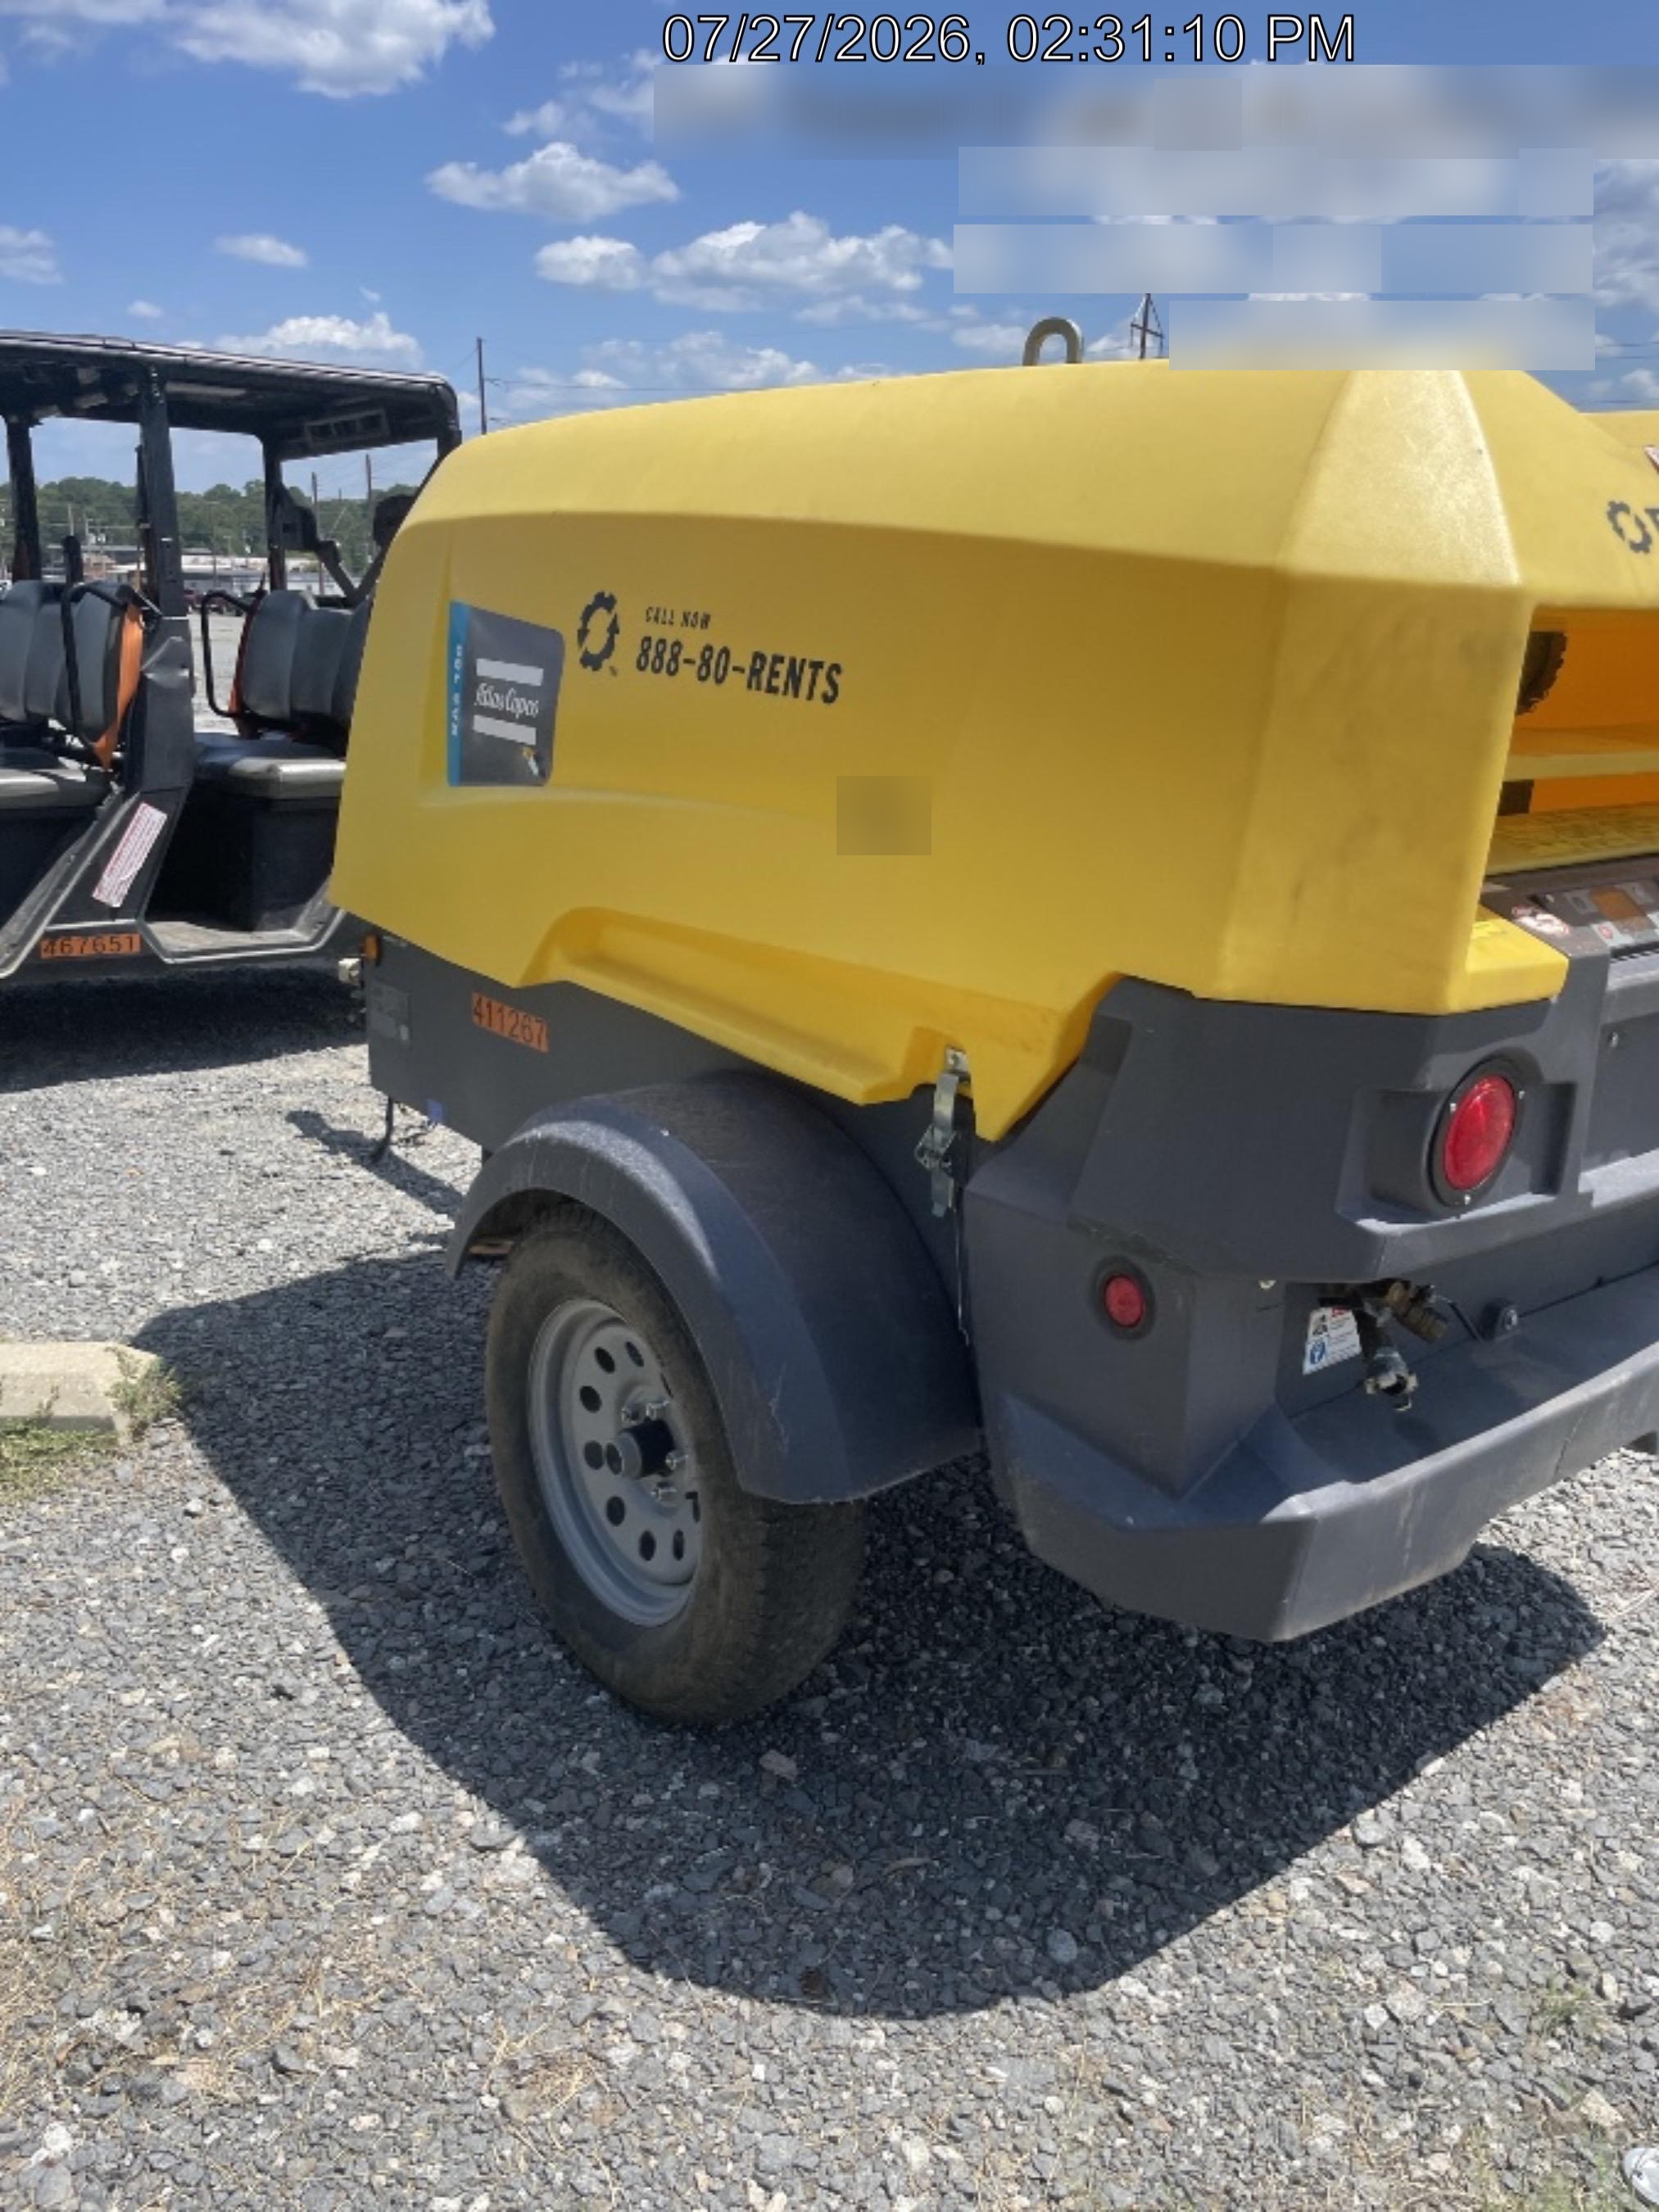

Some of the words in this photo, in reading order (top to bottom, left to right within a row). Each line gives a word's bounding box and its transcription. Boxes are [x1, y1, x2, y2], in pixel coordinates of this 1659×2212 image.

[646, 606, 675, 626] CALL
[680, 610, 711, 630] NOW
[636, 635, 842, 704] 888-80-RENTS
[474, 995, 545, 1048] 411267
